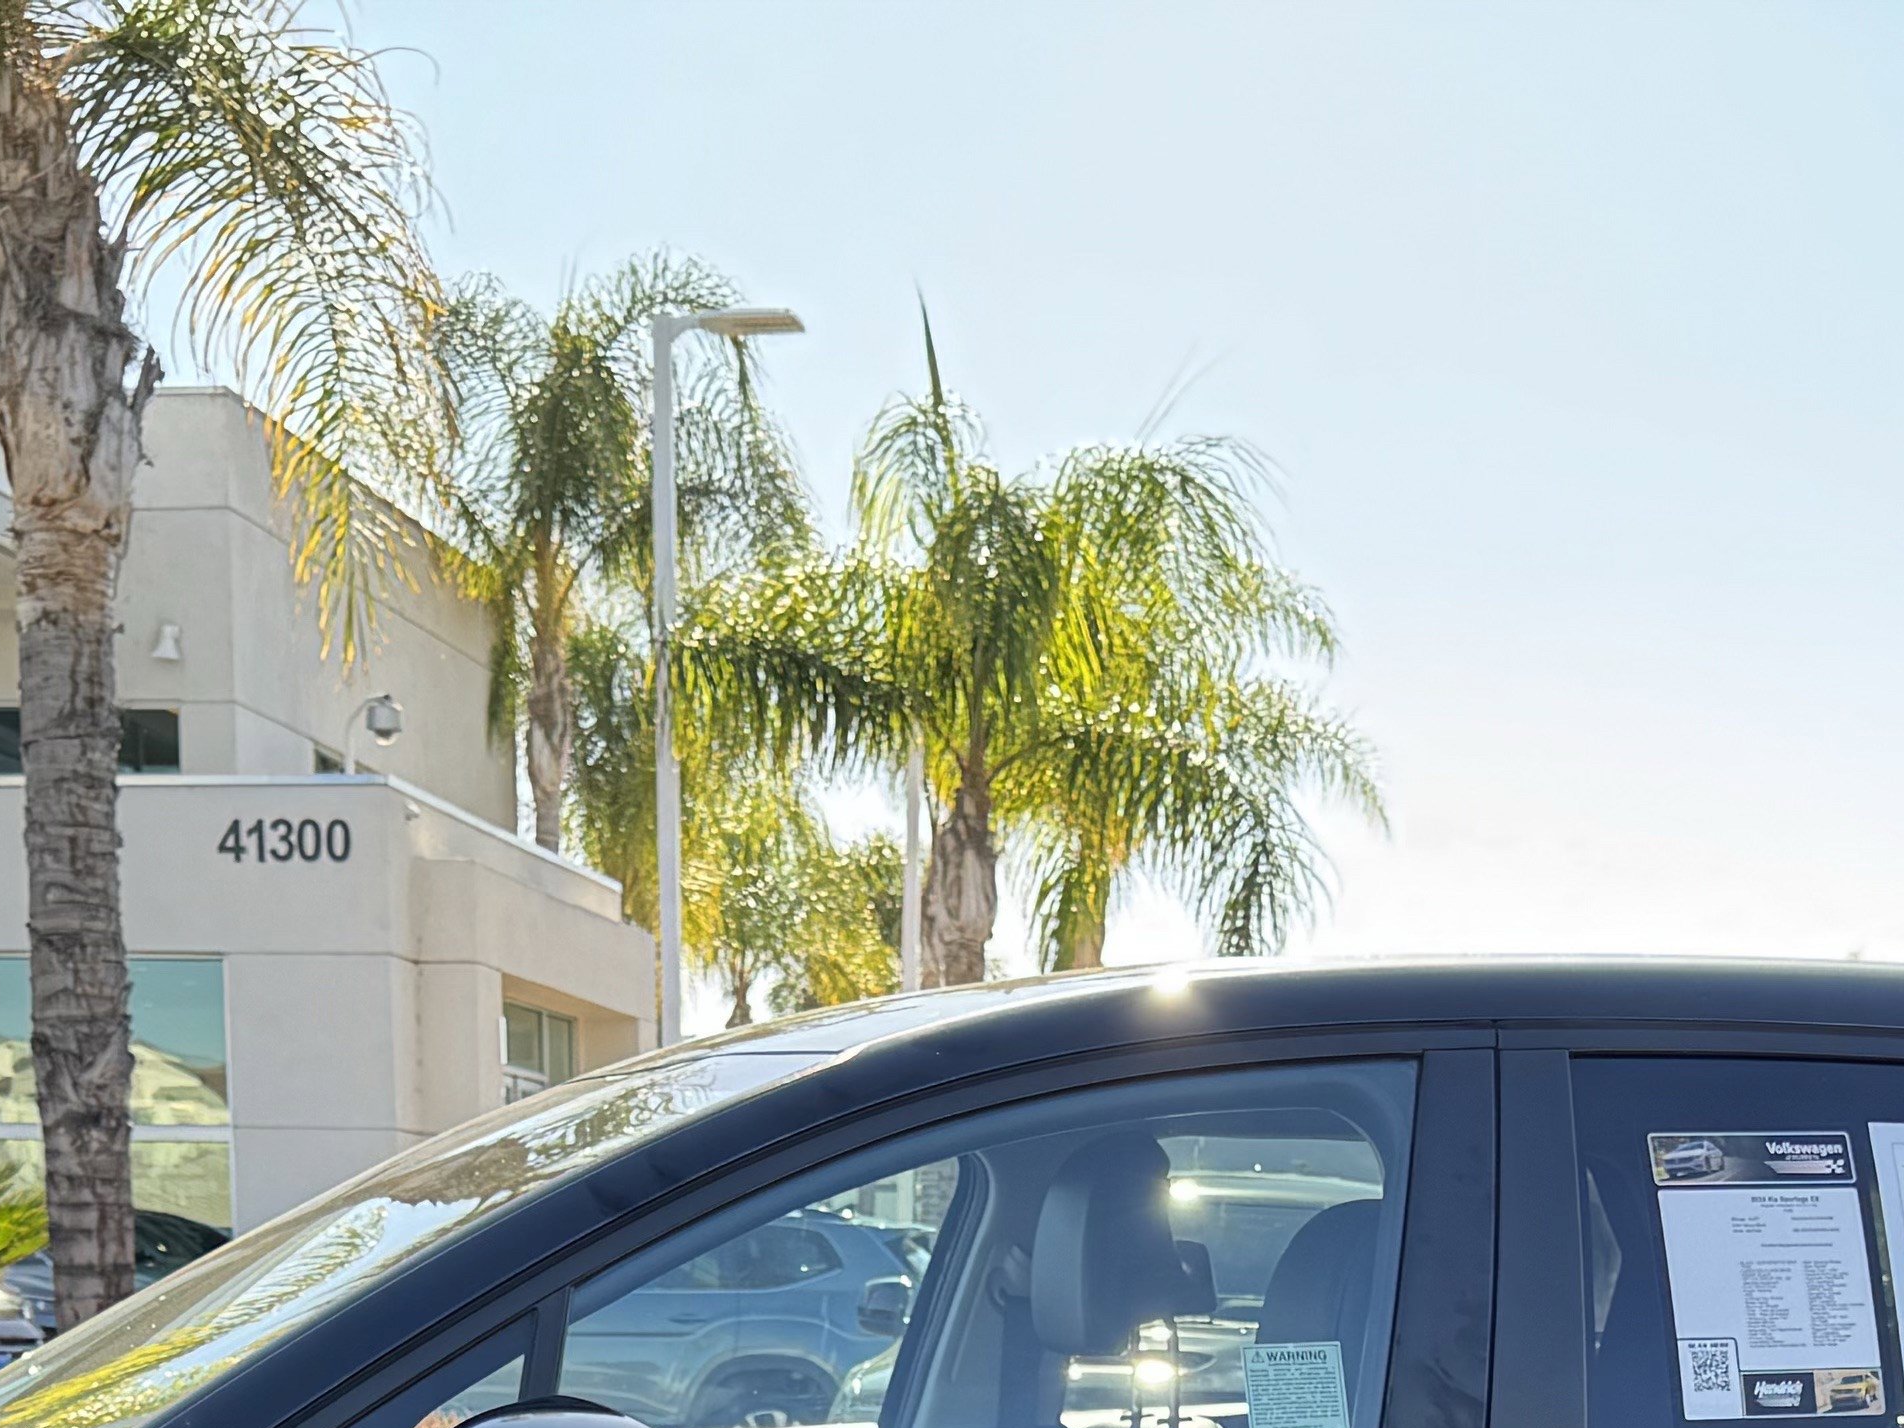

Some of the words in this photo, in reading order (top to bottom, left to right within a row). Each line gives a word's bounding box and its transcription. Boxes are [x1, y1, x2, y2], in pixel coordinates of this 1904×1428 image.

[217, 818, 351, 863] 41300
[1765, 1141, 1844, 1157] Volkswagen
[1266, 1349, 1328, 1362] WARNING
[1754, 1380, 1803, 1399] Hendrick
